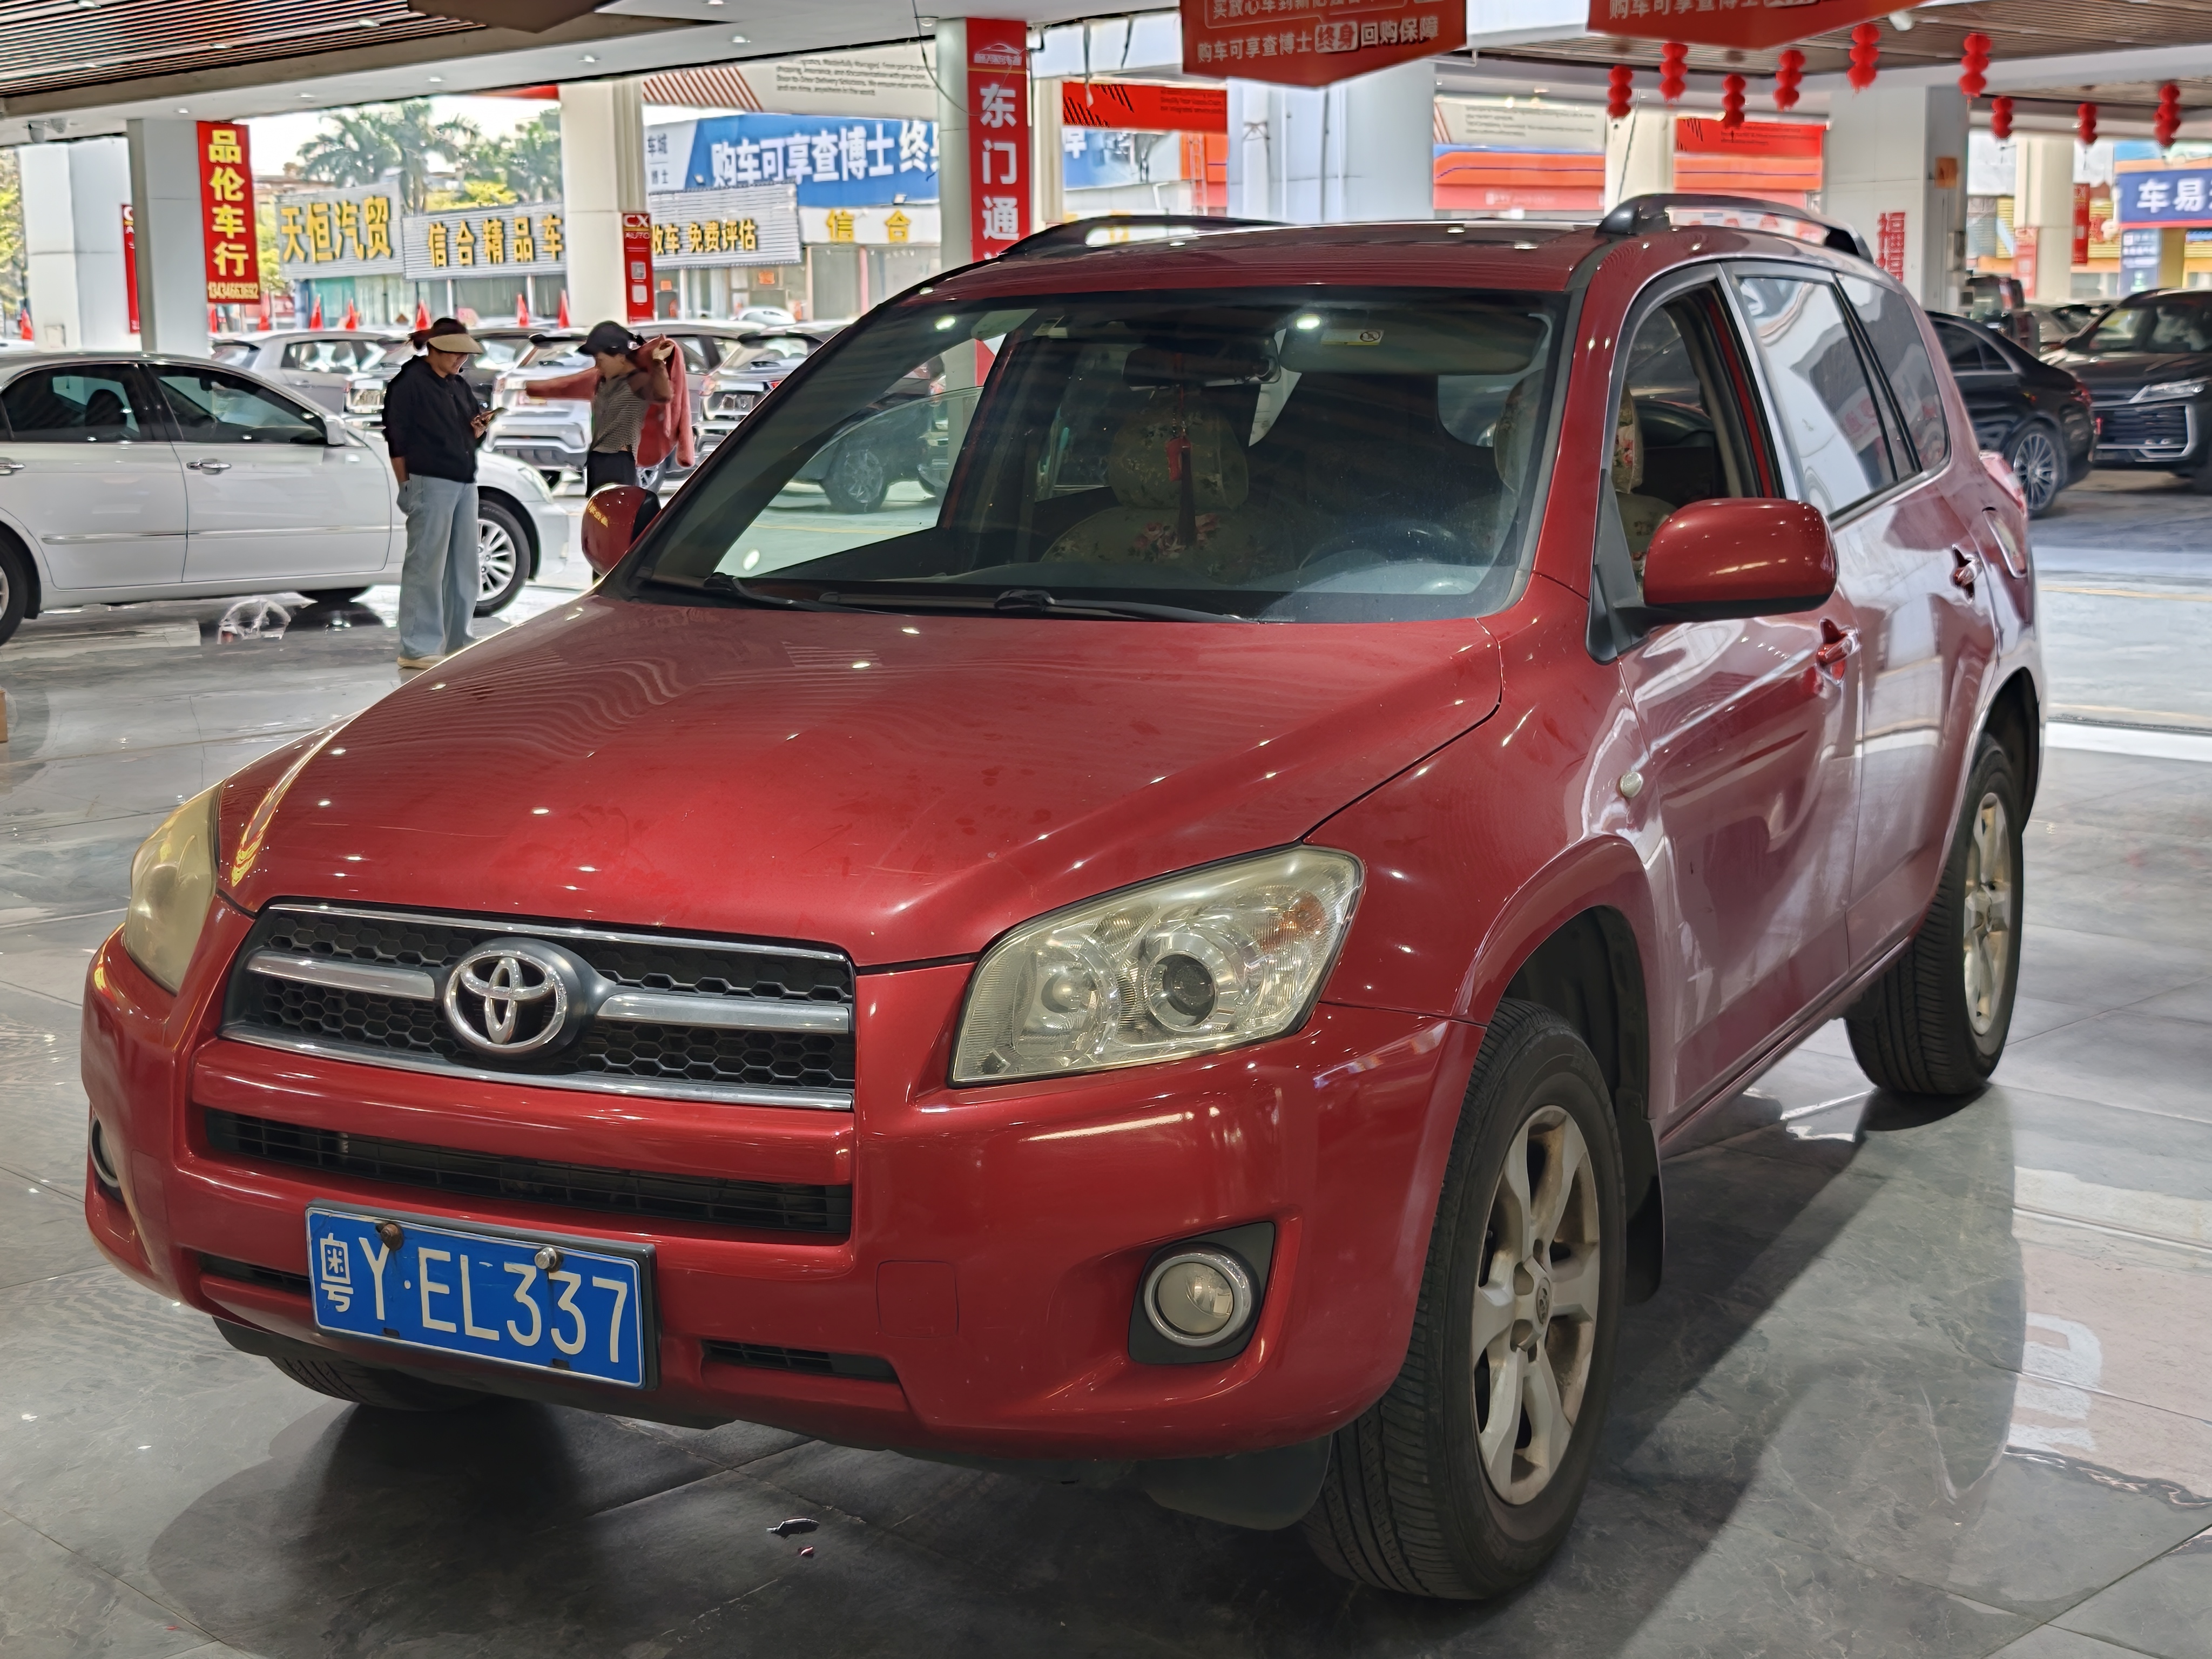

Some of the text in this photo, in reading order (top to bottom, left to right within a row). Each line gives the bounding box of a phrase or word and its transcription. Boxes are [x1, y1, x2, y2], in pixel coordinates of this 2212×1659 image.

[710, 120, 939, 188] 购车可享查博士终
[208, 130, 248, 276] 品伦车行
[280, 195, 393, 263] 天恒汽贸
[687, 218, 757, 253] 免费评估
[428, 213, 563, 267] 信合精品车
